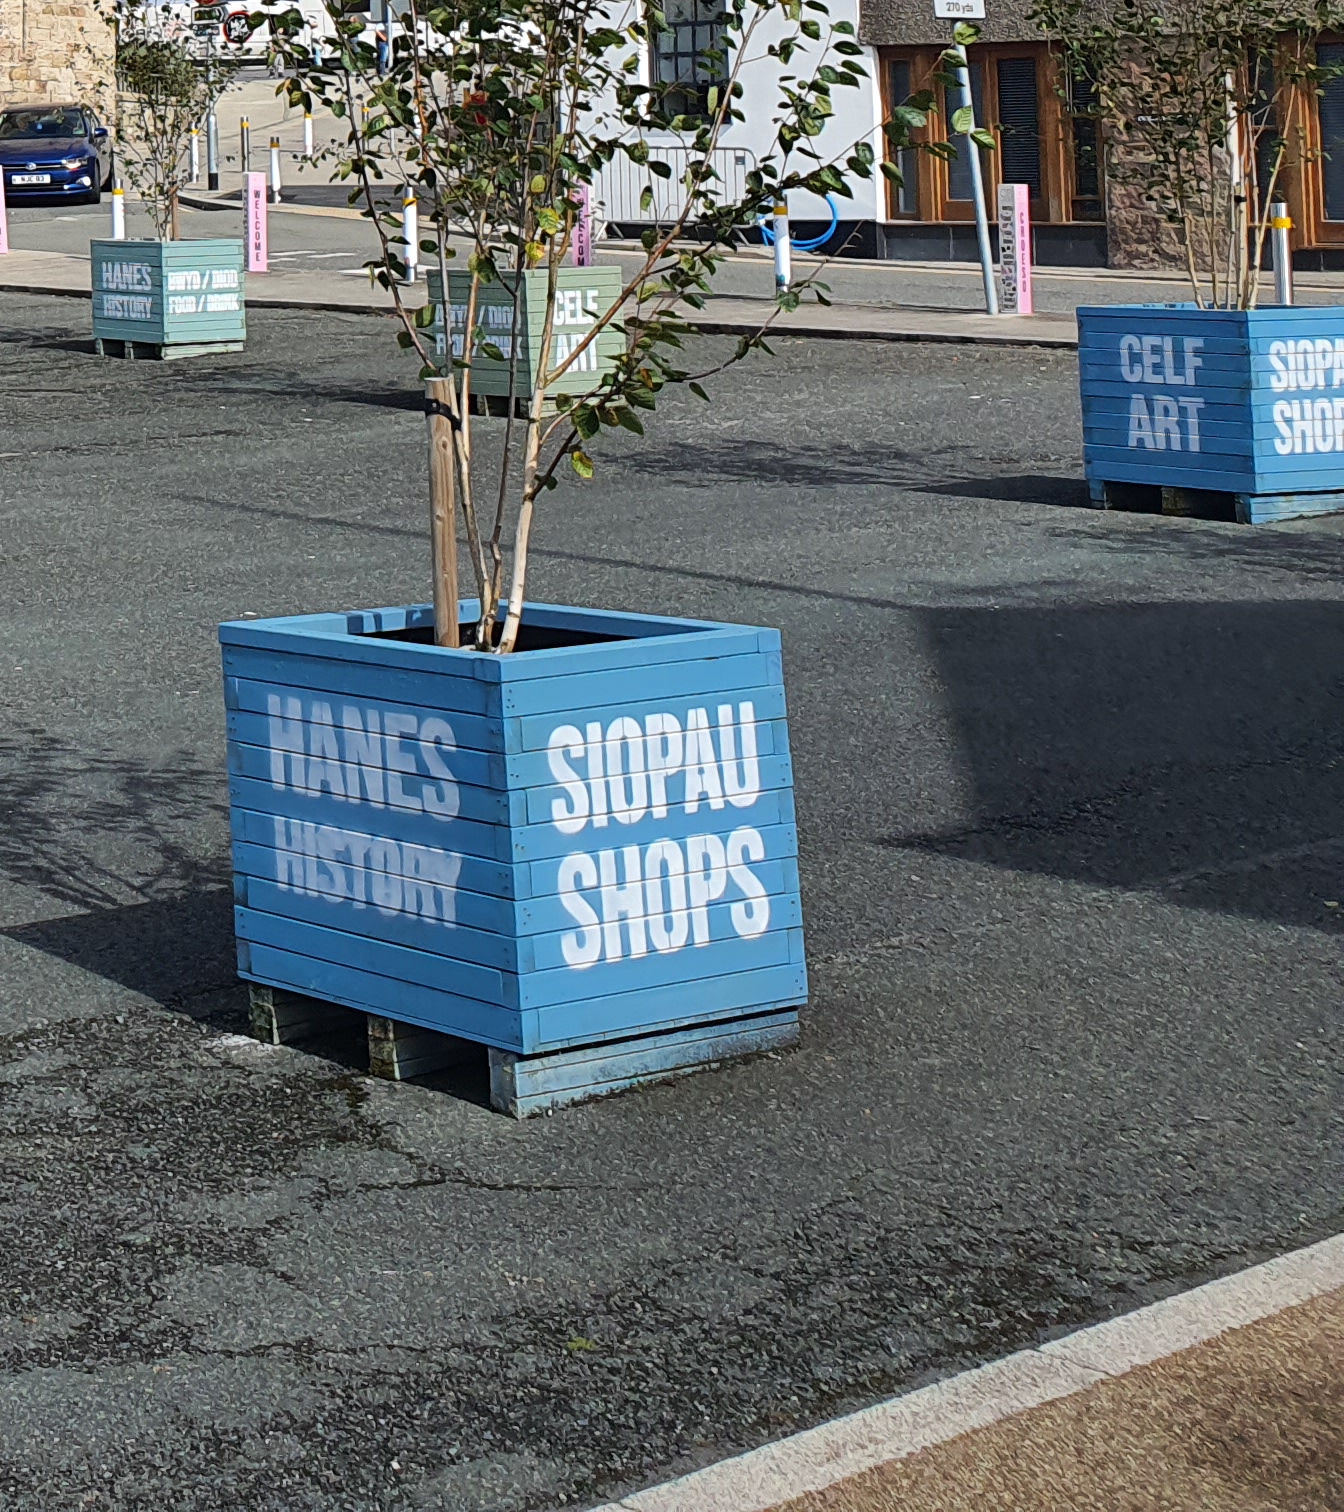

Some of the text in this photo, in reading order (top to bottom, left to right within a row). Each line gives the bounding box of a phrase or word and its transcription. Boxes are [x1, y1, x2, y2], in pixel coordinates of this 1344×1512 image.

[946, 2, 974, 14] 270 yds
[101, 261, 152, 291] HANES
[103, 294, 153, 319] HISTORY
[168, 295, 197, 314] FOOD
[554, 289, 599, 326] CELF
[555, 332, 600, 372] ART
[1119, 334, 1205, 386] CELF
[1128, 394, 1206, 452] ART
[266, 694, 461, 823] HANES
[546, 700, 761, 835] SIOPAU
[273, 814, 463, 929] HISTORY
[556, 825, 771, 970] SHOPS
